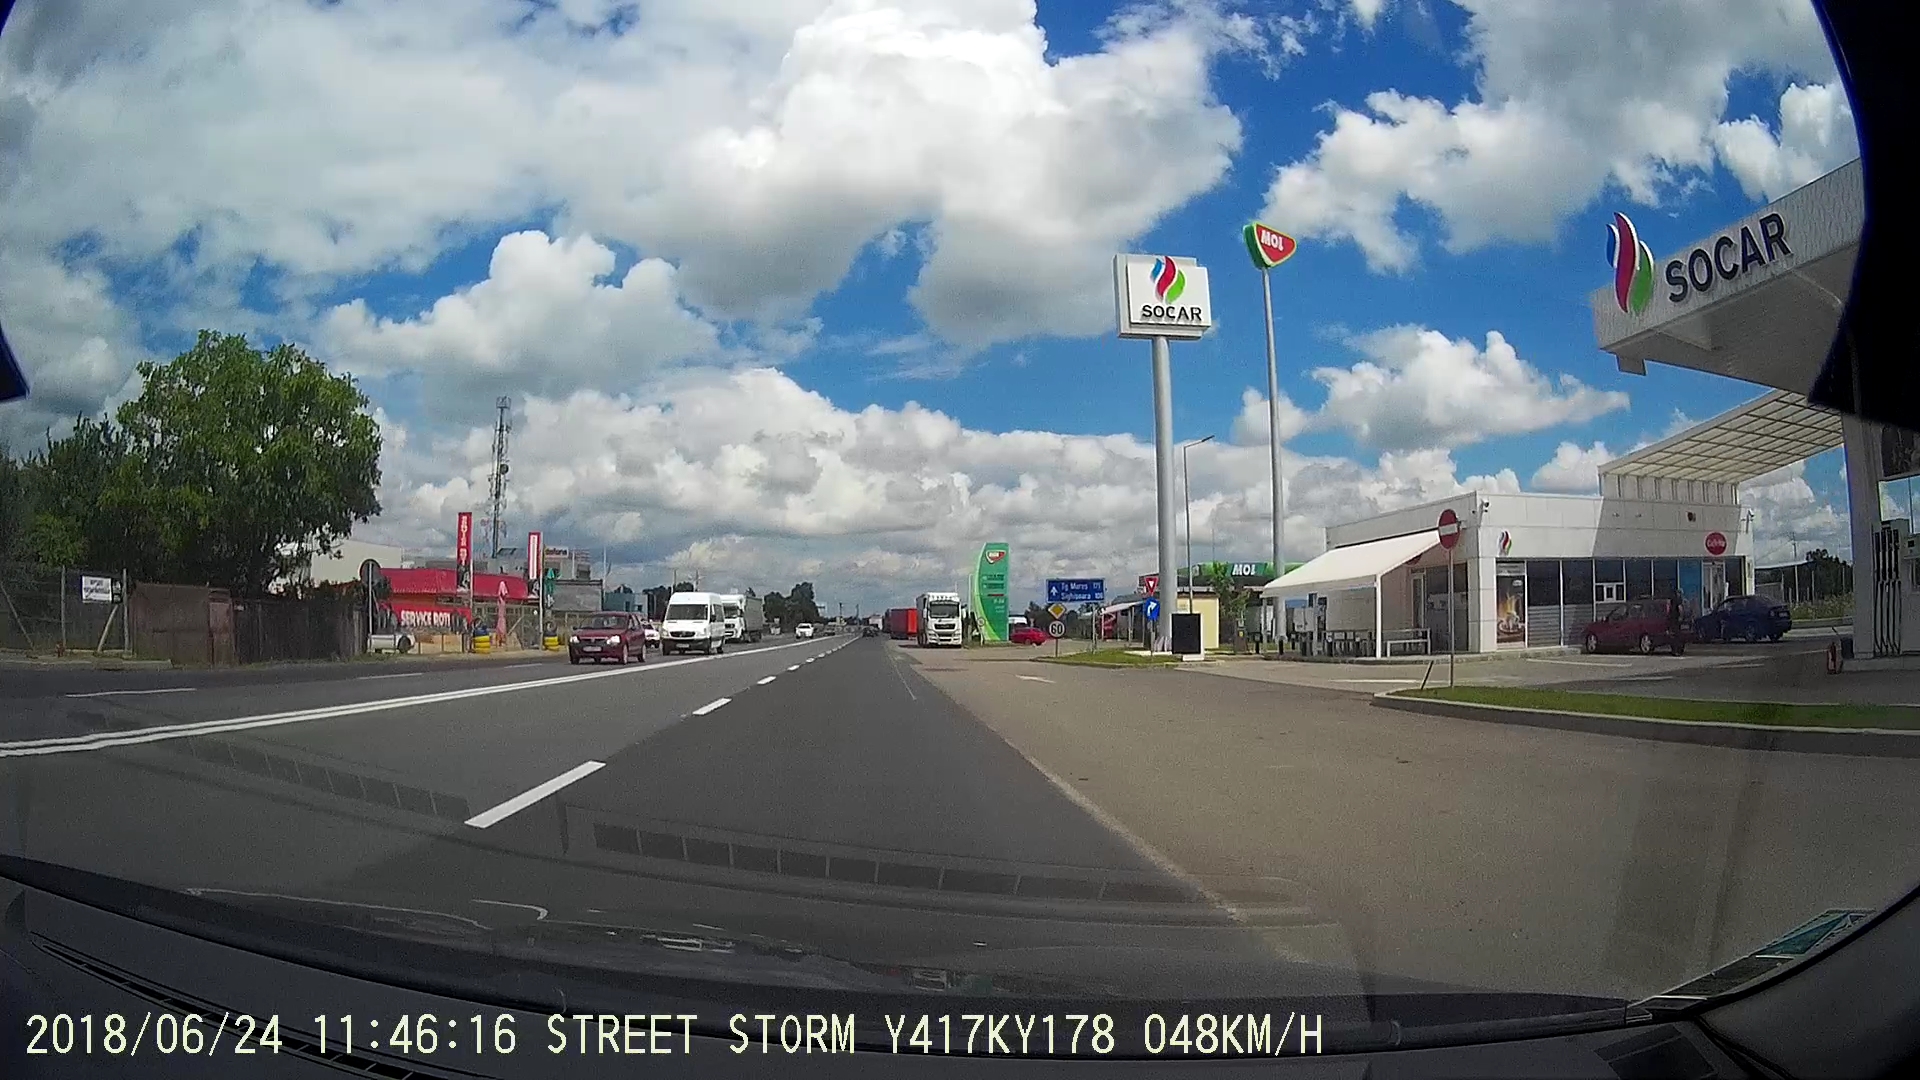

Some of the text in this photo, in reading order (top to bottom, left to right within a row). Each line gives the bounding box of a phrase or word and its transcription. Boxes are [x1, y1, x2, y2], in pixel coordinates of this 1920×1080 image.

[1261, 230, 1283, 251] MOL
[1664, 212, 1792, 303] SOCAR
[1142, 304, 1202, 321] SOCAR
[1232, 564, 1256, 575] MOL
[401, 609, 432, 627] SERVICE
[1051, 623, 1063, 634] 60
